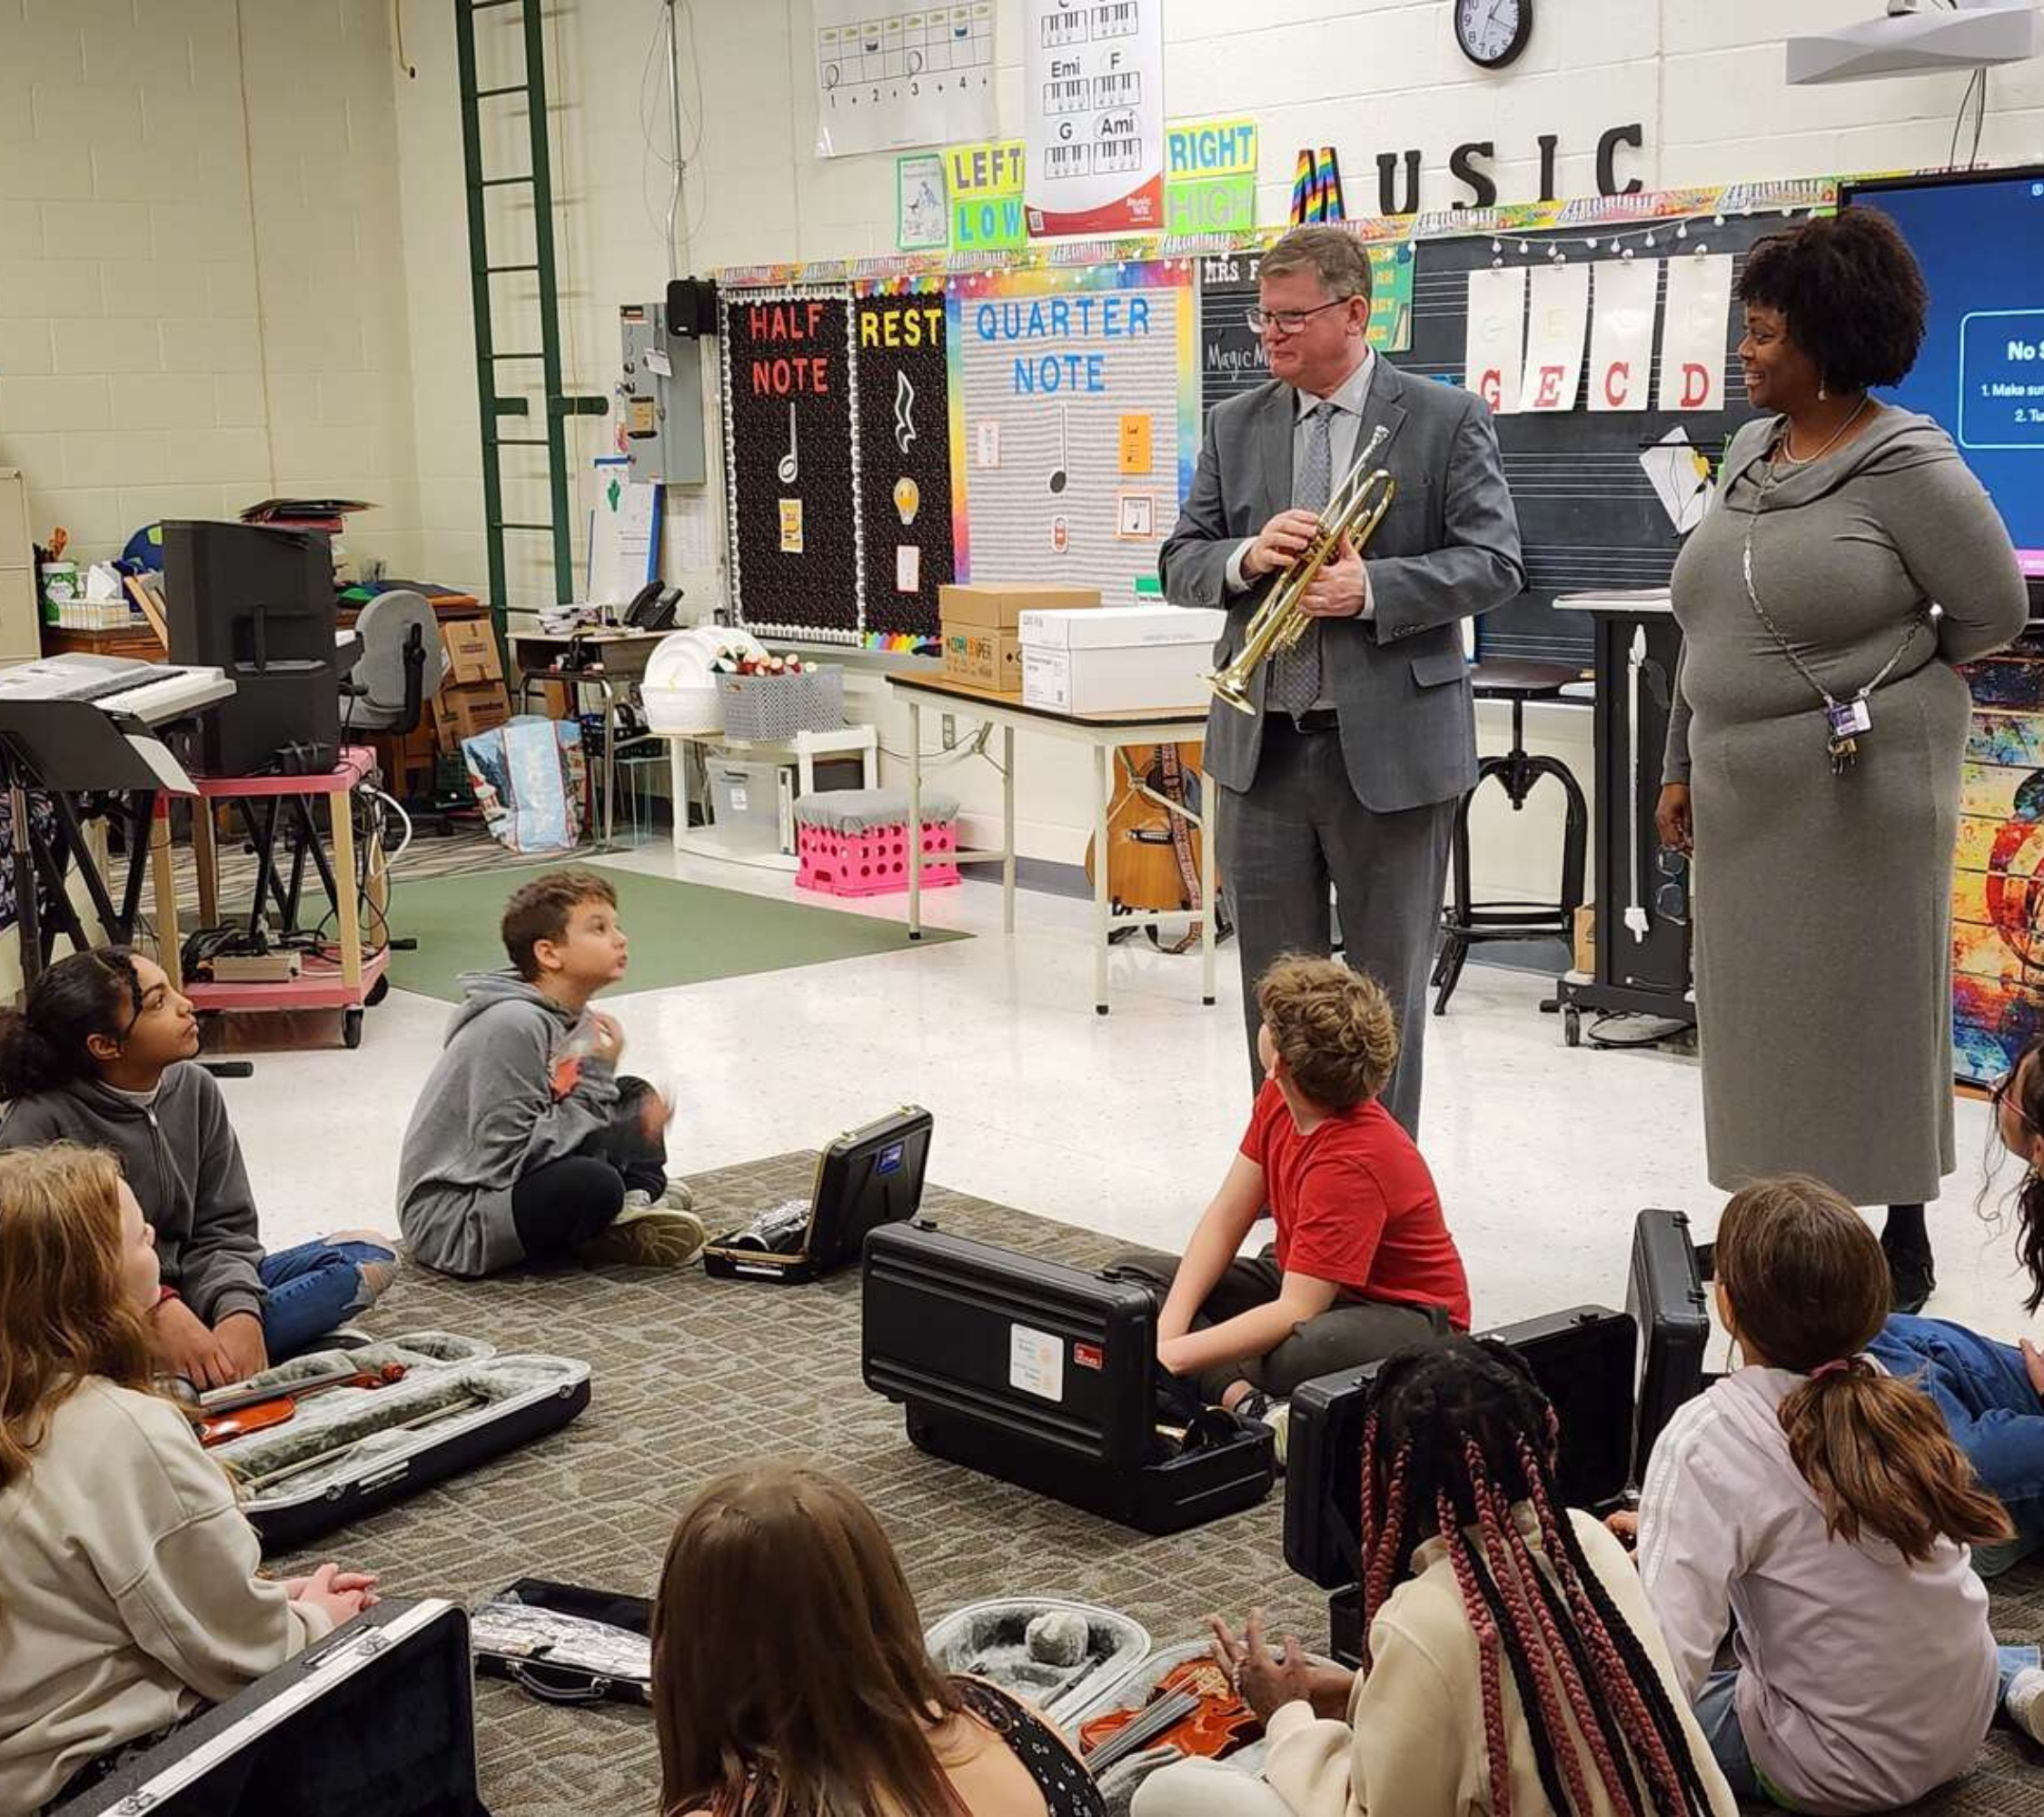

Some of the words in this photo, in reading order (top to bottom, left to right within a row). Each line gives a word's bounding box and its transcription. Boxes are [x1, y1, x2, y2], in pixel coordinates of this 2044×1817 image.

[1051, 56, 1080, 78] Emi
[1110, 53, 1121, 70] F
[911, 83, 919, 95] 3
[1059, 122, 1073, 140] G
[1101, 111, 1134, 135] Ami
[955, 148, 1020, 189] LEFT
[1168, 125, 1253, 172] RIGHT
[1290, 124, 1643, 225] MUSIC
[960, 201, 1020, 241] LOW
[1166, 185, 1252, 228] HIGH
[750, 303, 823, 341] HALF
[860, 309, 942, 347] REST
[977, 297, 1149, 341] QUARTER
[2008, 340, 2036, 361] No
[753, 358, 829, 394] NOTE
[1015, 354, 1105, 394] NOTE
[1480, 369, 1501, 413] G
[1534, 365, 1564, 407] E
[1605, 362, 1629, 407] C
[1681, 362, 1710, 407] D
